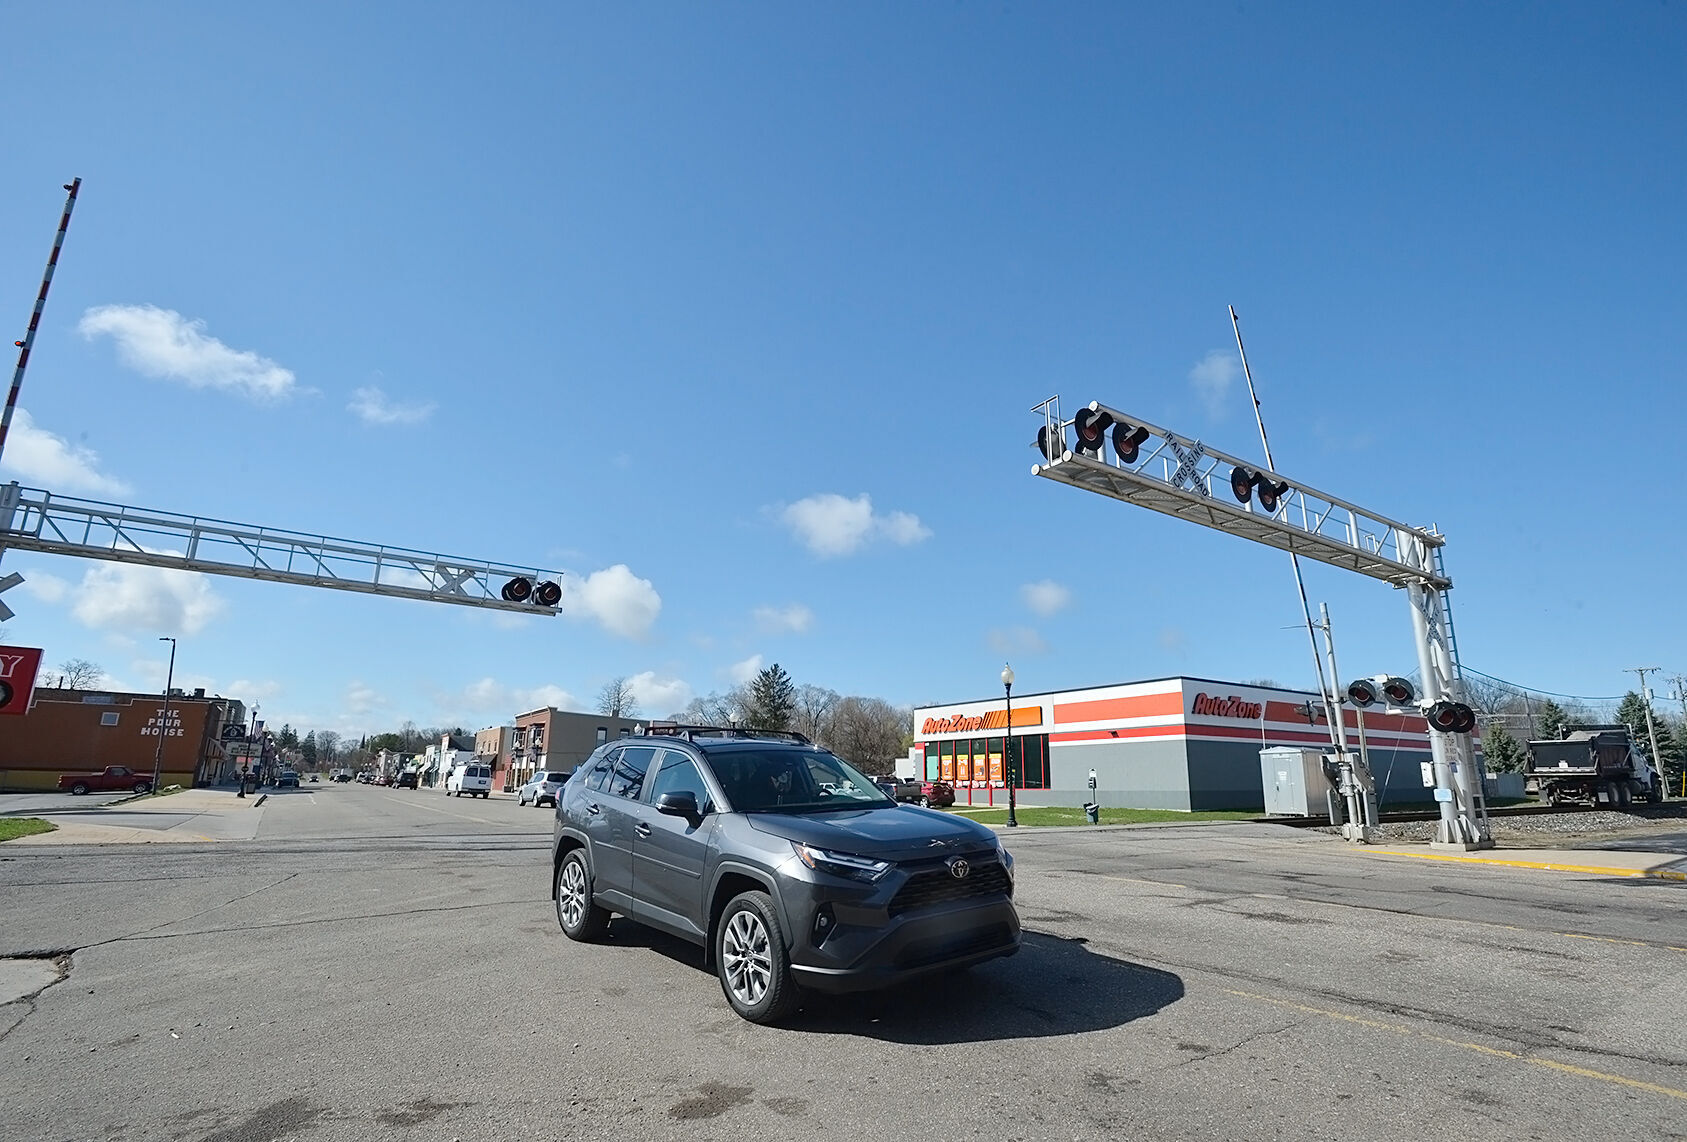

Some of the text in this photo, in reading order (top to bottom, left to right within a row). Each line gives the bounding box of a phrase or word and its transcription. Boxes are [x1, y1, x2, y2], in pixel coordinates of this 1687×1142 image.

[1166, 432, 1208, 497] RAIL ROAD
[1173, 442, 1204, 488] CROSSING
[1192, 692, 1262, 719] AutoZone
[148, 718, 181, 727] POUR
[921, 714, 981, 734] AutoZone
